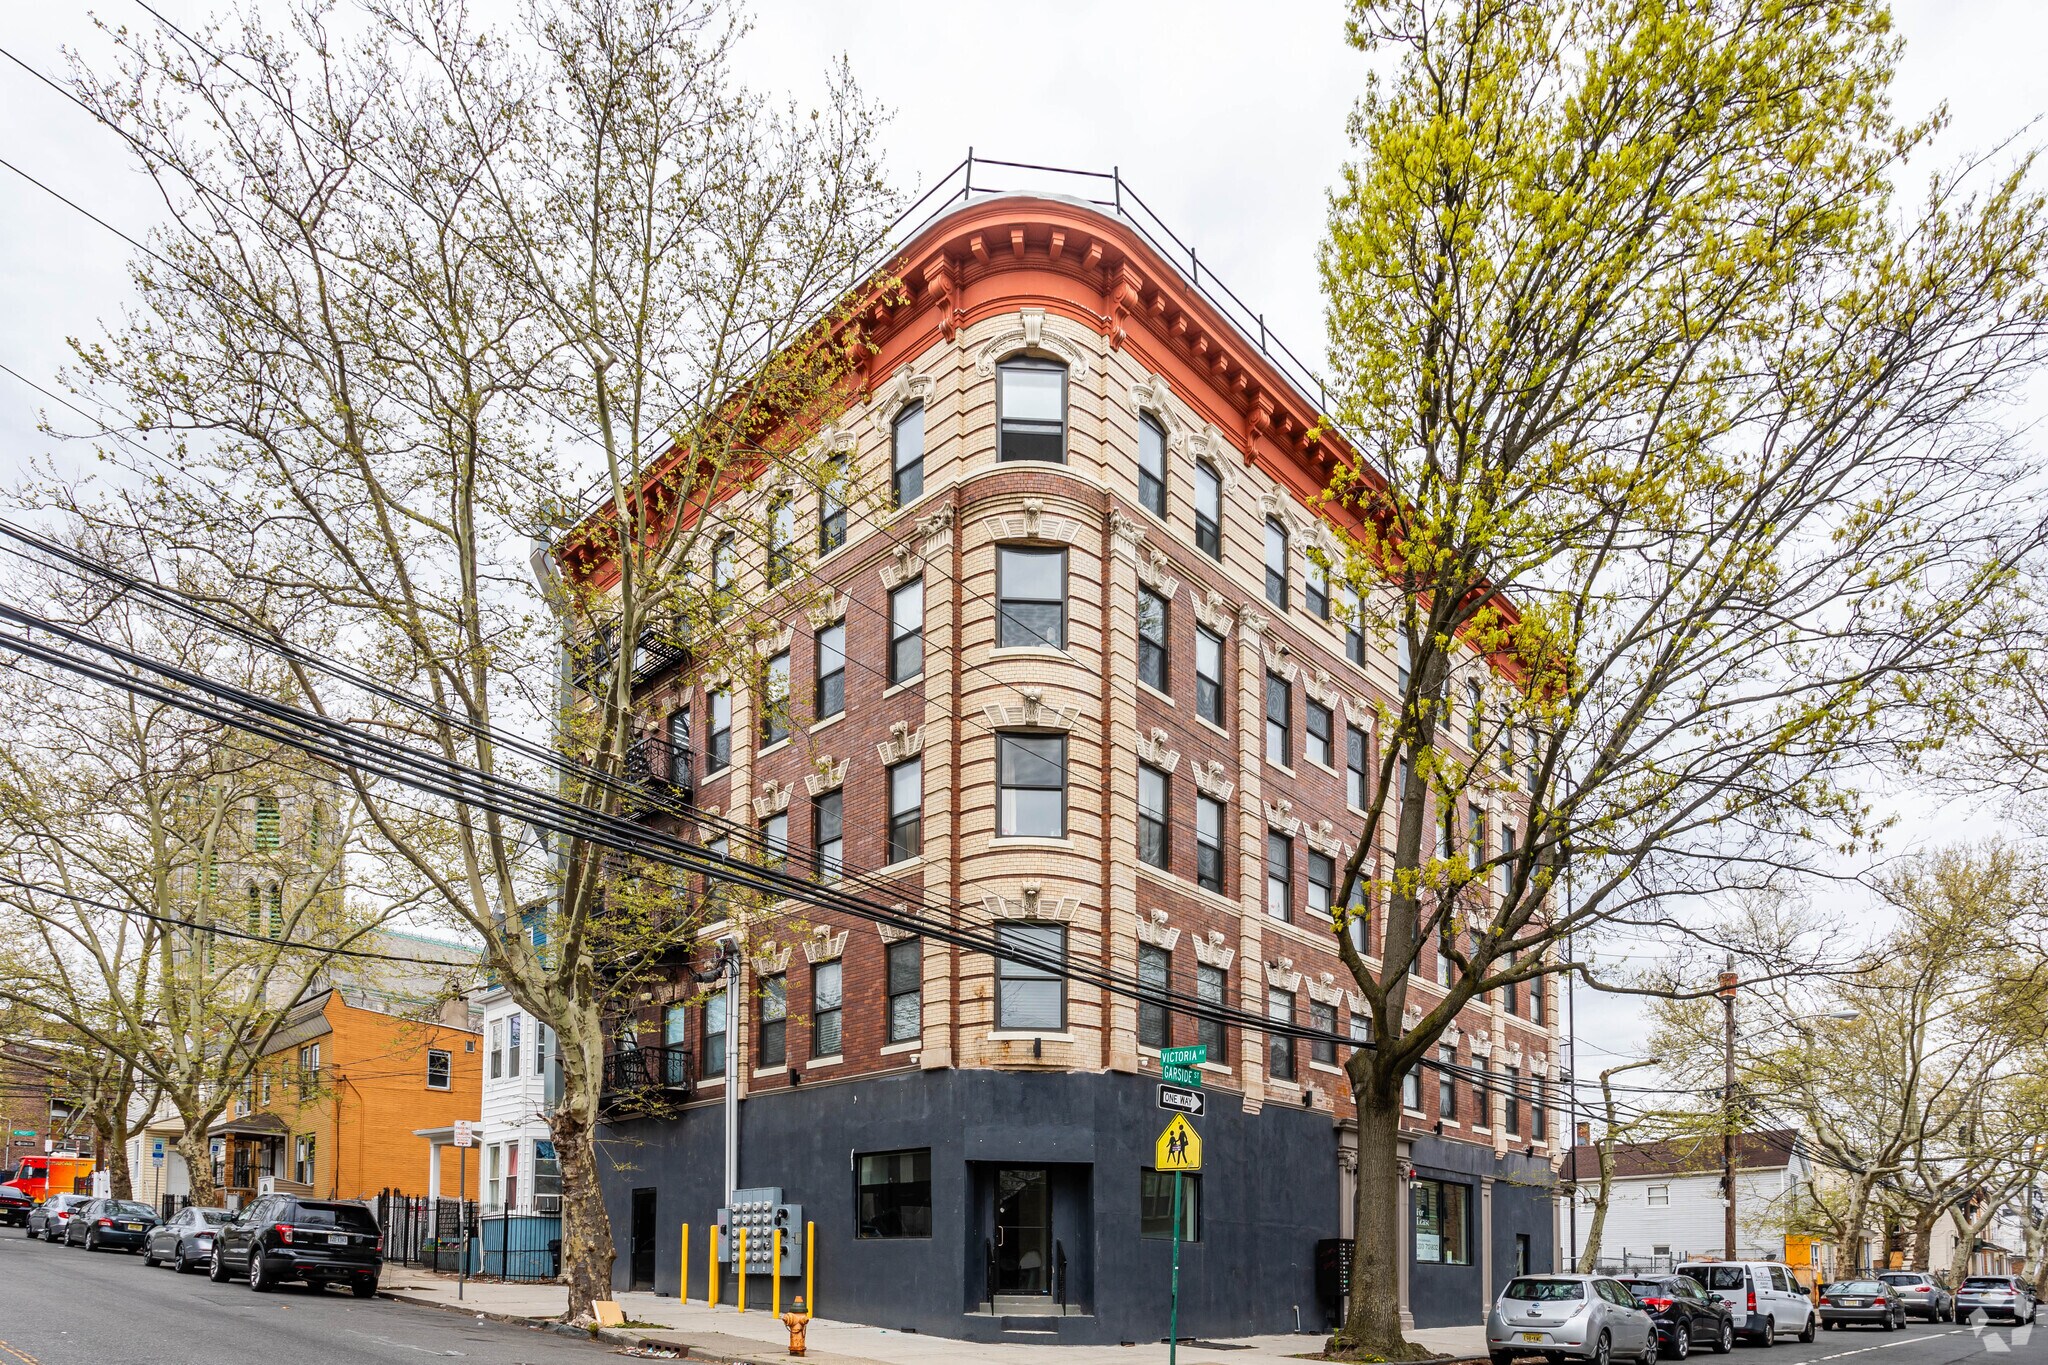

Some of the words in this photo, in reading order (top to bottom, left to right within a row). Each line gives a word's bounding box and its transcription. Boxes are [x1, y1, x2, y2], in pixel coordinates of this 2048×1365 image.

[1162, 1050, 1197, 1063] VICTORIA
[1164, 1065, 1192, 1083] GARSIDE
[1165, 1092, 1177, 1103] ONE
[1180, 1096, 1192, 1106] WAY
